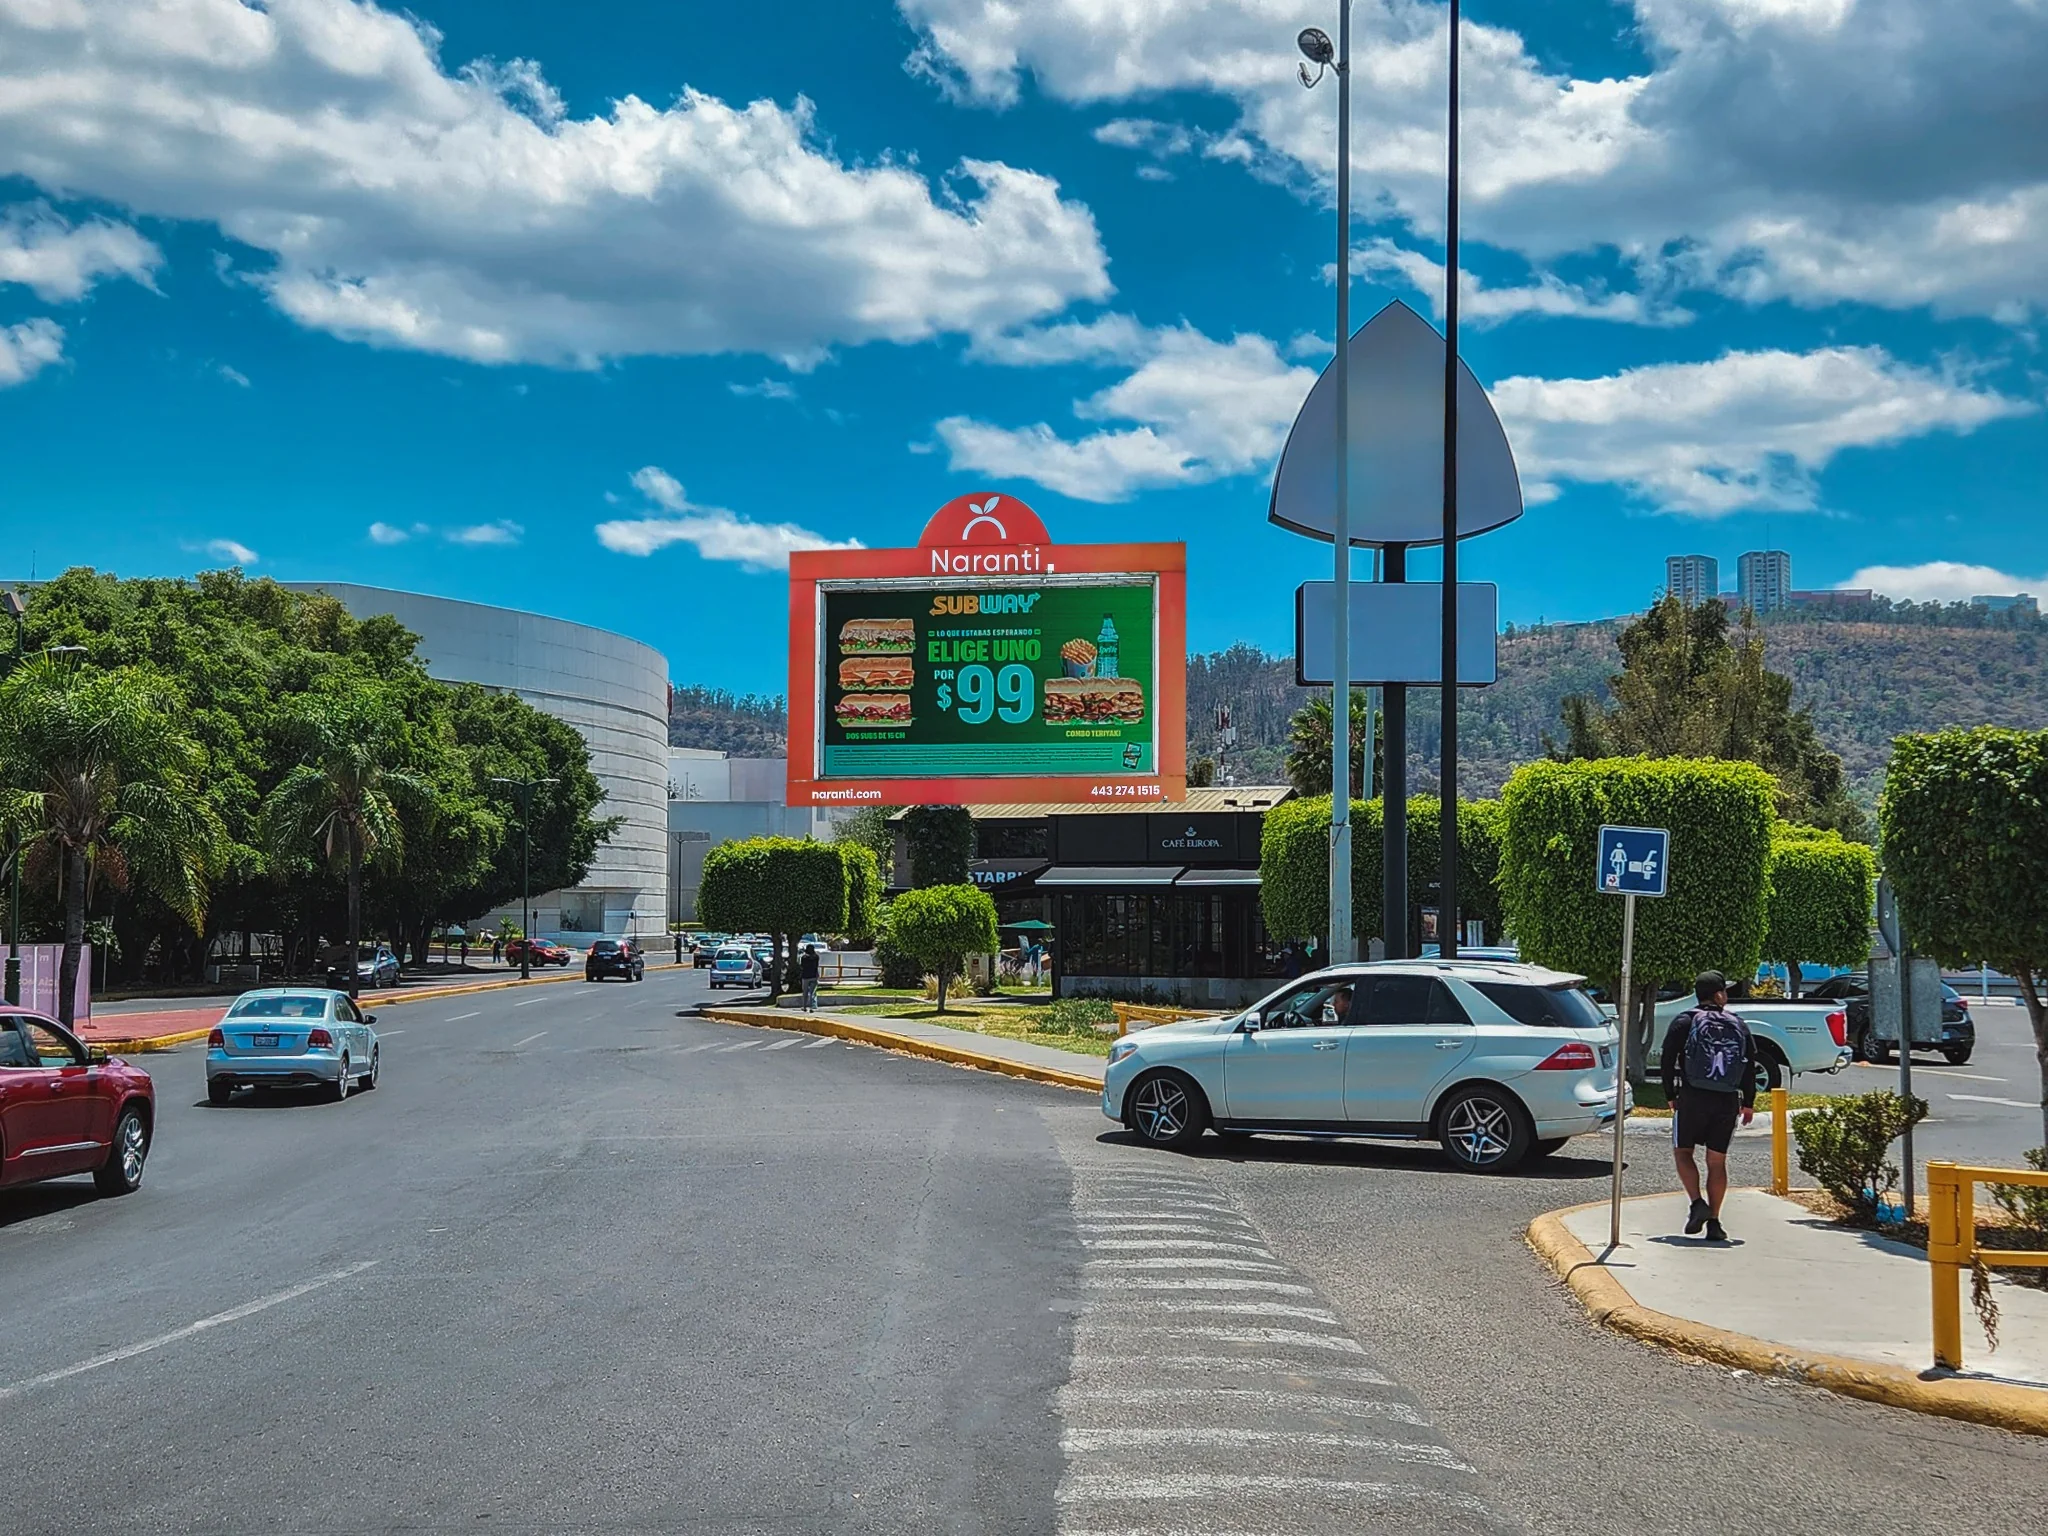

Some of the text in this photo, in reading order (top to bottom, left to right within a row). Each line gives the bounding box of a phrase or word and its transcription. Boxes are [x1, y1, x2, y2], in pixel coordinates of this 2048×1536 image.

[931, 547, 1040, 573] Naranti
[929, 592, 1041, 616] SUBWAY
[946, 630, 960, 638] QUE
[961, 629, 991, 637] ESTABAS
[992, 628, 1033, 636] ESPERANDO
[928, 639, 1041, 662] ELIGE UNO
[934, 669, 955, 680] POR
[1091, 729, 1122, 737] TERIYAKI
[811, 788, 881, 799] naranti.com
[1091, 785, 1160, 796] 443 274 1515
[1162, 838, 1185, 848] CAFÉ
